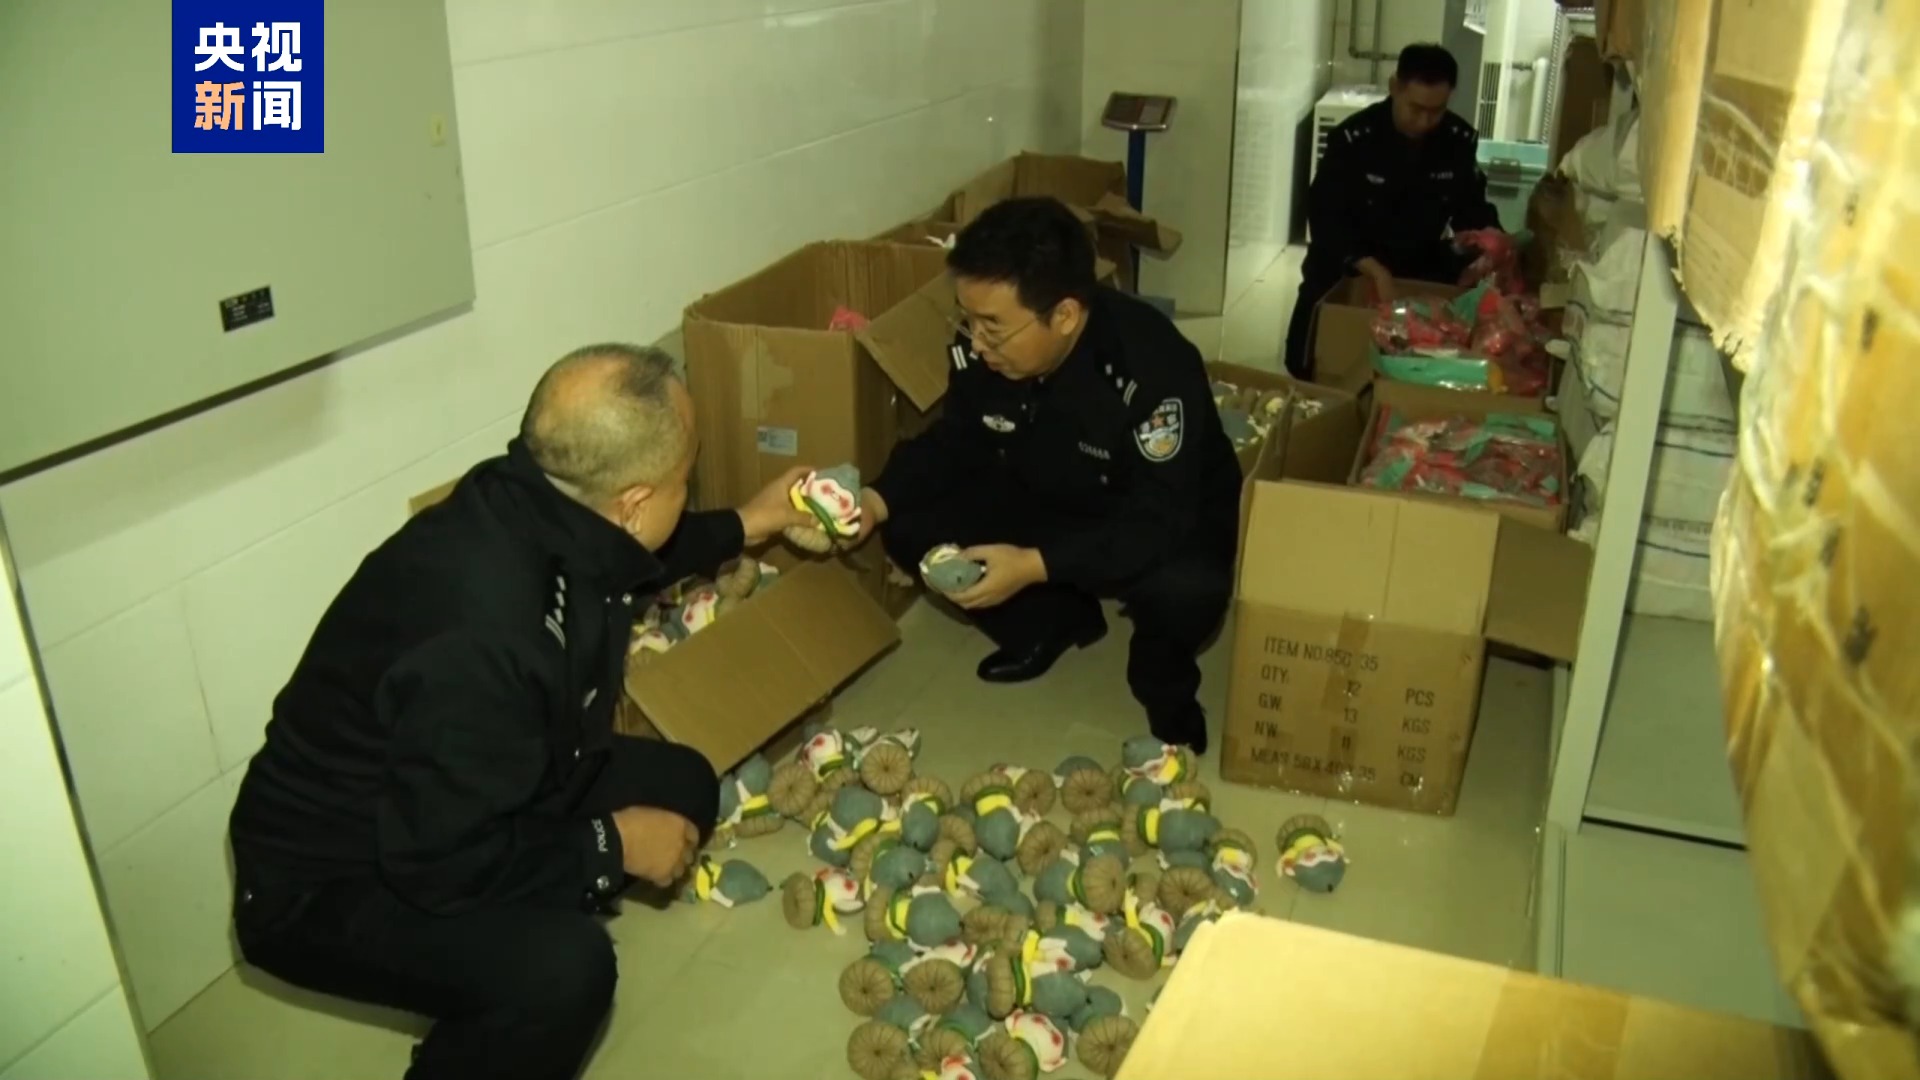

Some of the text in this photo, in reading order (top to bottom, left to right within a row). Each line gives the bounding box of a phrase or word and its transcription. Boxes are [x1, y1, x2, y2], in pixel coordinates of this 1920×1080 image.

[1264, 635, 1299, 658] ITEM
[1405, 687, 1435, 708] PCS
[1344, 707, 1358, 724] 13
[1402, 716, 1431, 735] KGS
[1398, 745, 1427, 763] KGS
